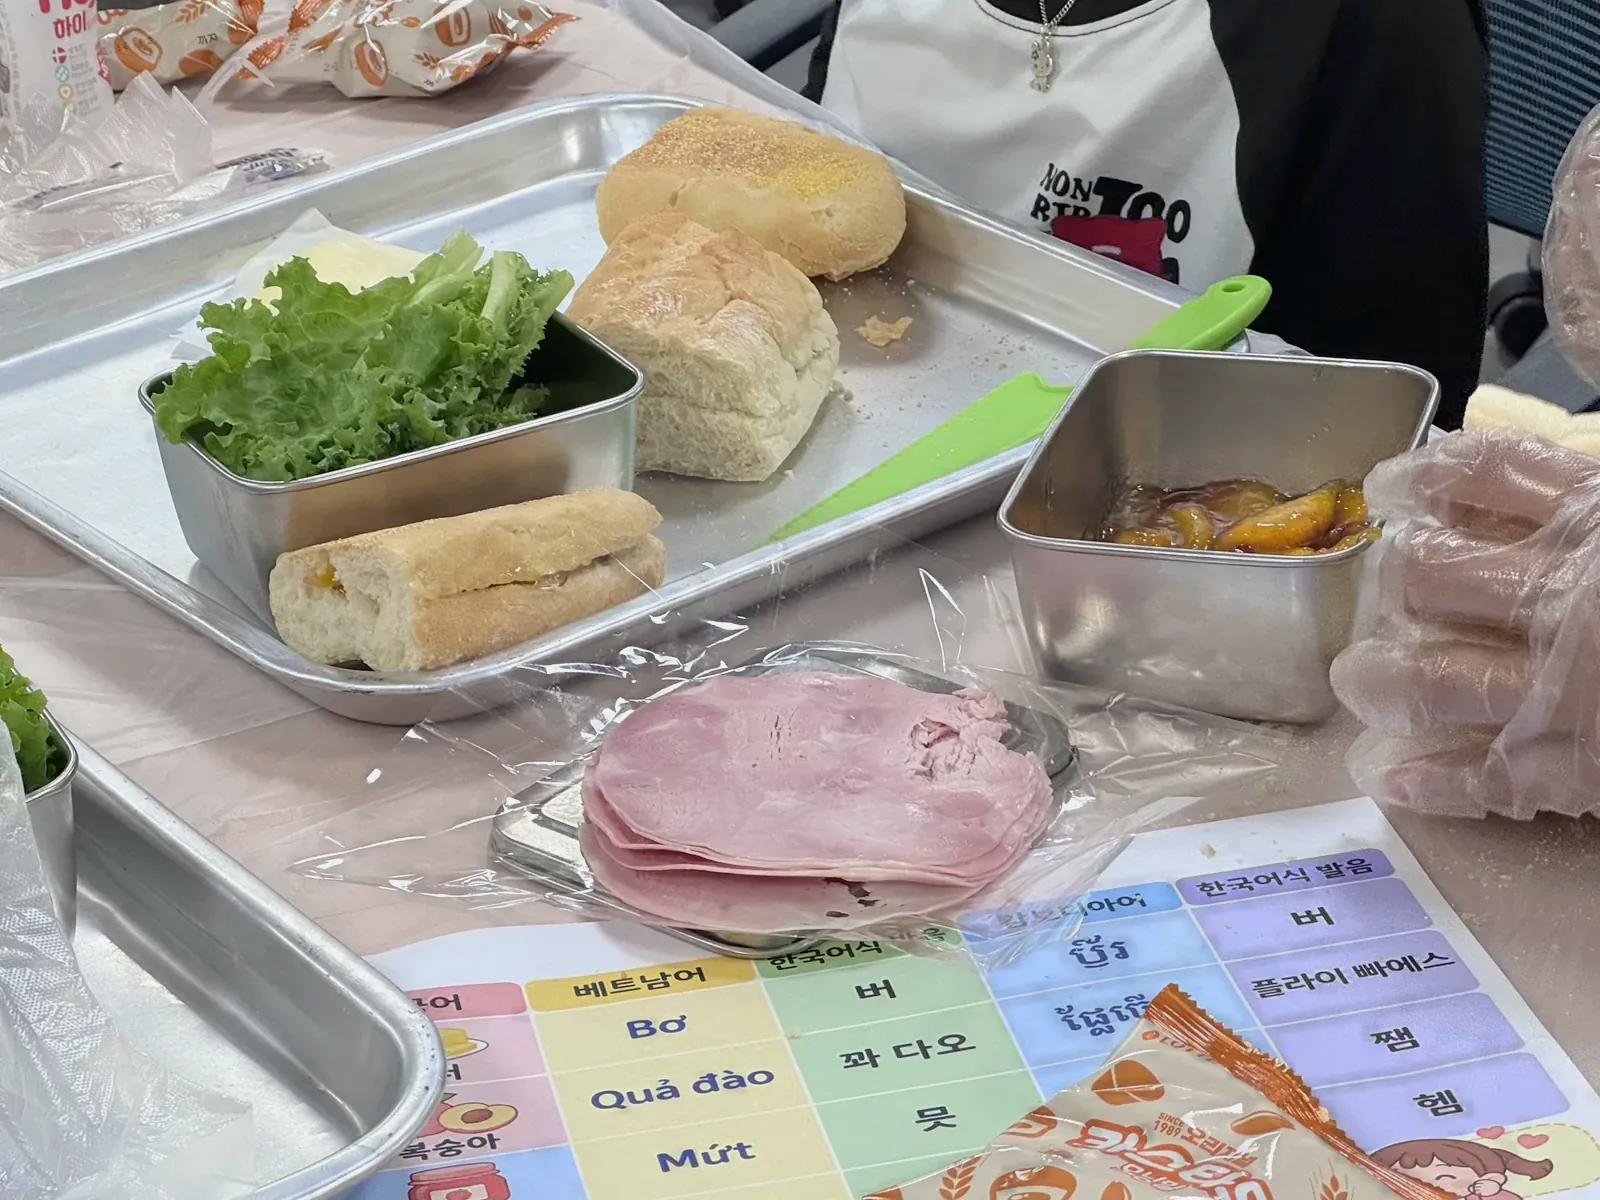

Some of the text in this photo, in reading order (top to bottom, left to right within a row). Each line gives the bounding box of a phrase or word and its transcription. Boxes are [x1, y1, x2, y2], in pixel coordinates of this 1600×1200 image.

[1040, 163, 1093, 202] NON
[1196, 857, 1374, 897] 한국어식 발음
[1290, 907, 1335, 926] 버
[767, 940, 883, 970] 한국어식
[573, 966, 707, 998] 베트남어
[1250, 951, 1456, 999] 플라이 빠에스
[854, 979, 897, 999] 버
[626, 1014, 688, 1040] Bơ
[1369, 1027, 1421, 1053] 쨈
[891, 1033, 977, 1060] 다오
[590, 1068, 775, 1110] Quả đào
[1153, 1119, 1182, 1138] 1989
[1157, 1112, 1185, 1127] SINCE
[399, 1133, 501, 1160] 복숭아
[656, 1141, 756, 1173] Mứt
